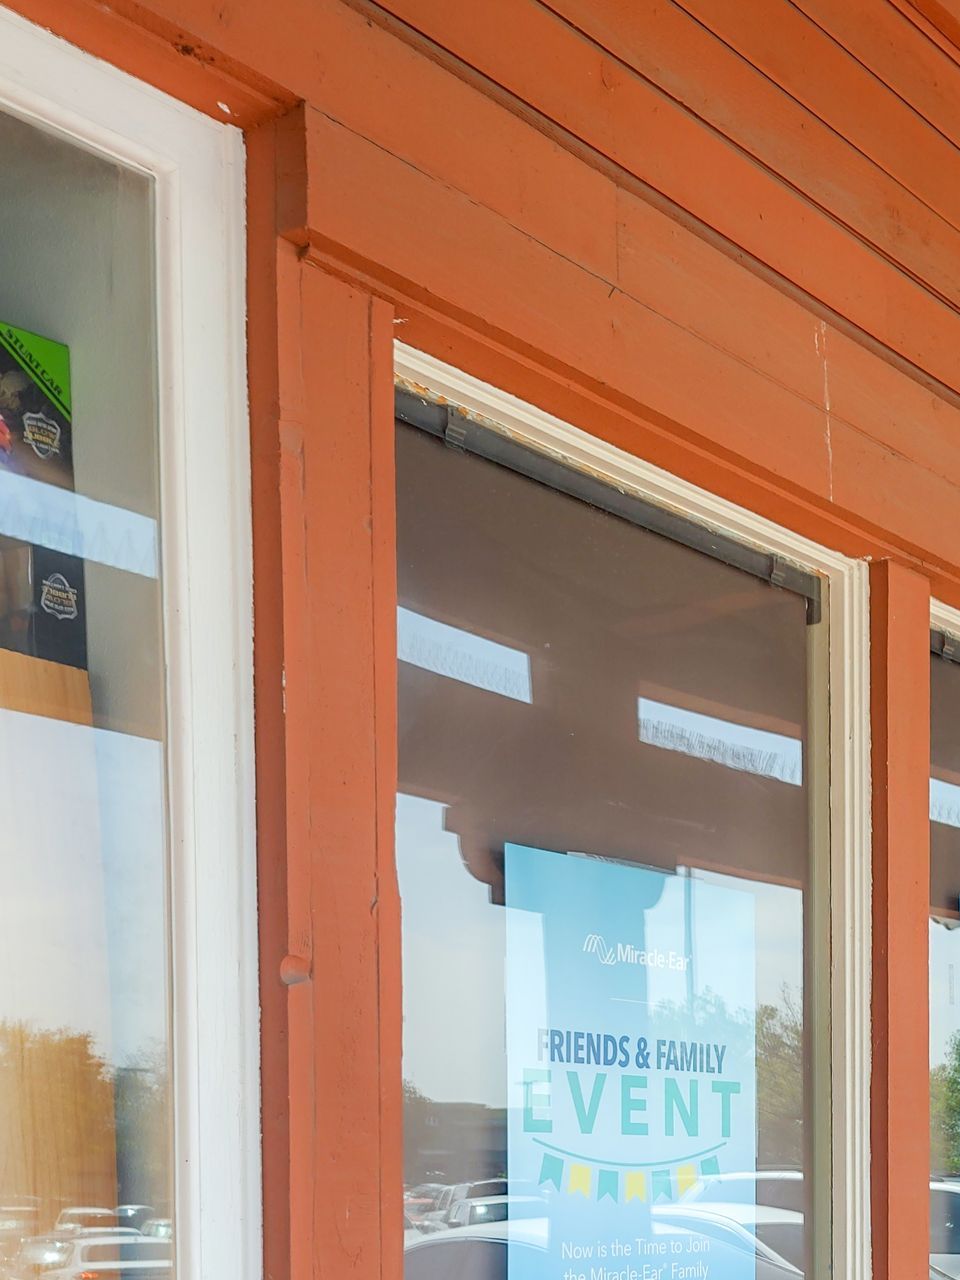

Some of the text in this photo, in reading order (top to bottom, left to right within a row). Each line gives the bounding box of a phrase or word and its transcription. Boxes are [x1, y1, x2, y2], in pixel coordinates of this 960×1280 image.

[40, 369, 63, 395] CAR
[537, 1028, 727, 1074] FRIENDS & FAMILY
[522, 1067, 742, 1138] EVENT
[561, 1238, 711, 1260] Now is the Time to Join
